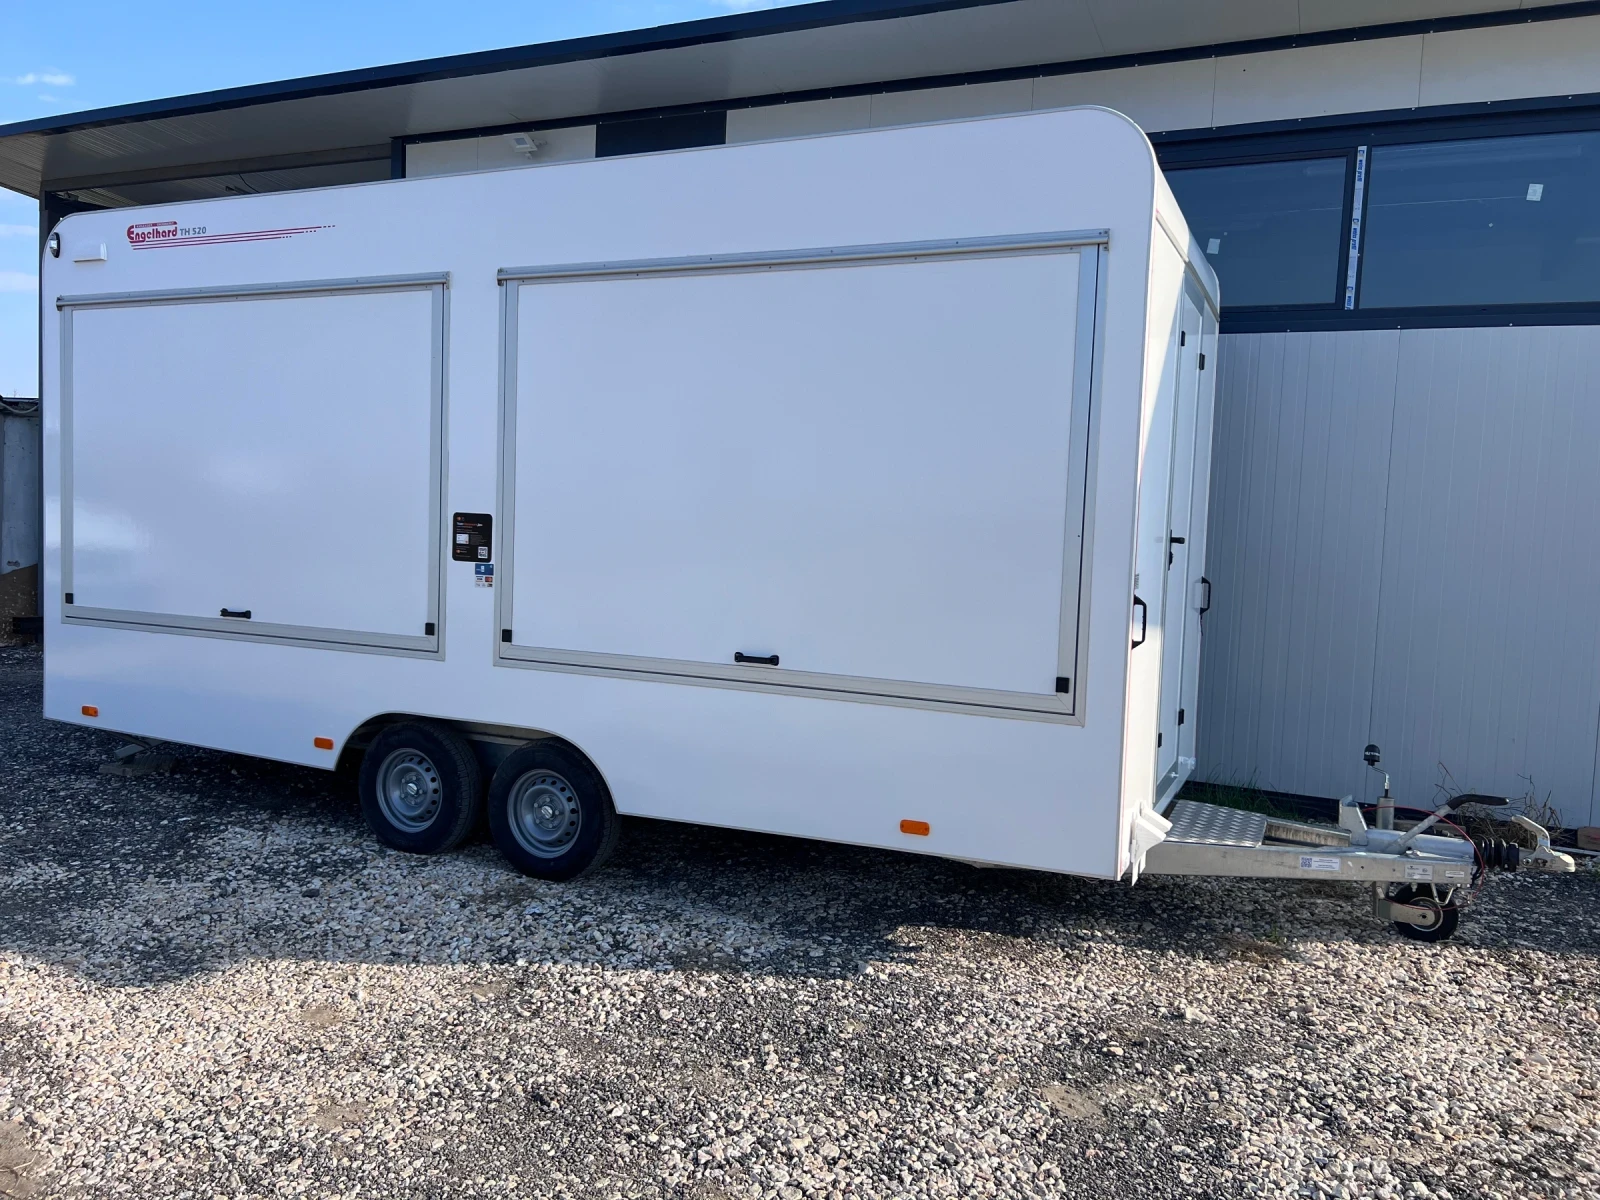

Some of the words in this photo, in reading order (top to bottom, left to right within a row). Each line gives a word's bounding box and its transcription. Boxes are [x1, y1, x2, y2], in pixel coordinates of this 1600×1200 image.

[127, 224, 178, 243] Engelhard
[179, 228, 190, 236] TH
[192, 226, 207, 236] 520
